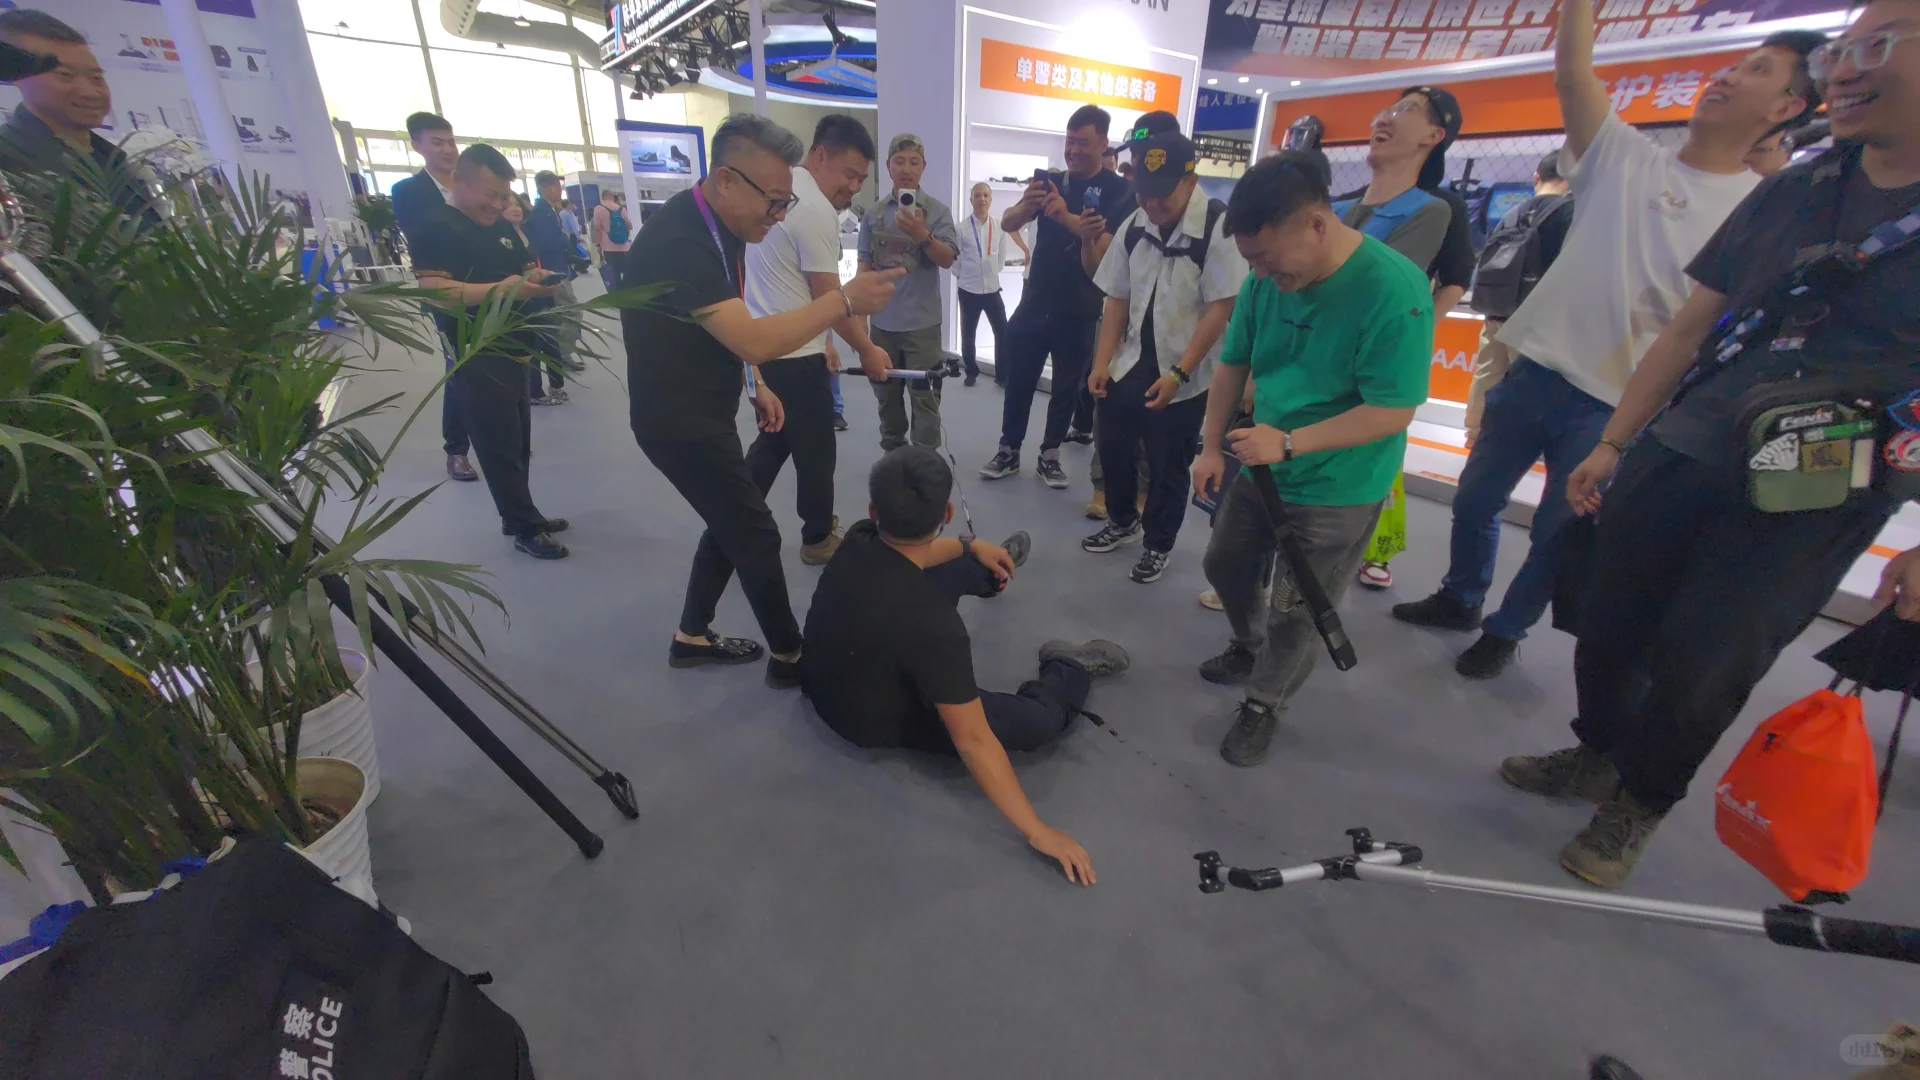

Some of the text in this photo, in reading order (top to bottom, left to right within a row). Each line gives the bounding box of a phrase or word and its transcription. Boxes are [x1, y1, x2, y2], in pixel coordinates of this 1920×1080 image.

[1016, 56, 1157, 103] 单警类及其他类装备
[1603, 68, 1727, 112] 护装
[280, 1003, 315, 1080] 警察
